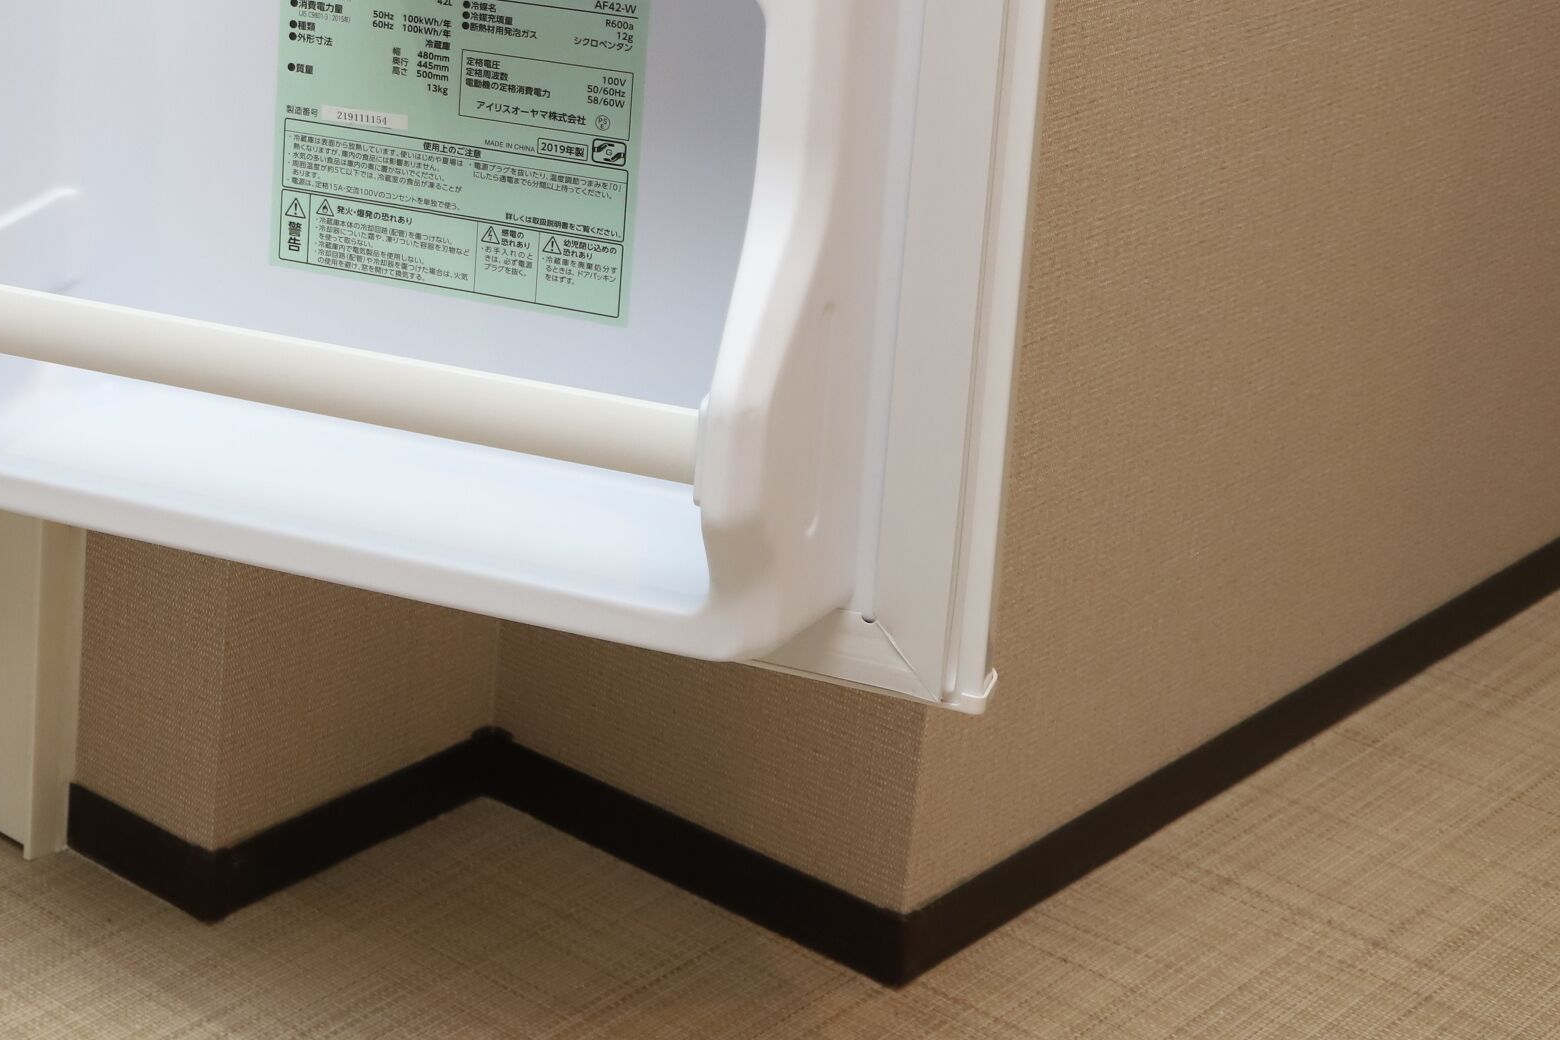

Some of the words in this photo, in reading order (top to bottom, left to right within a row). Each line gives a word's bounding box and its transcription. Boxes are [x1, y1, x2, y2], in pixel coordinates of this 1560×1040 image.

[594, 0, 637, 14] AF42-W
[373, 10, 394, 21] 50Hz
[402, 14, 452, 29] 100kWh/年
[605, 19, 634, 31] R600a
[372, 20, 394, 31] 60Hz
[402, 24, 452, 39] 100kWh/年
[573, 36, 633, 52] シクロペンタン
[617, 32, 634, 44] 12g
[425, 39, 451, 52] 冷蔵庫
[417, 51, 450, 63] 480mm
[466, 57, 501, 70] 定格電圧
[392, 56, 409, 67] 奥行
[416, 60, 450, 73] 445mm
[392, 66, 409, 77] 高さ
[416, 70, 449, 82] 500mm
[465, 67, 509, 81] 定格周波数
[465, 78, 551, 99] 電動機の定格消費電力
[602, 76, 627, 87] 100V
[427, 83, 449, 96] 13kg
[587, 84, 626, 98] 50/60Hz
[587, 95, 626, 108] 58/60W
[286, 104, 319, 118] 製造番号
[476, 100, 587, 126] アイリスオーヤマ株式会社
[337, 111, 388, 126] 219111154
[423, 141, 482, 159] 使用上のご注意
[484, 138, 504, 148] MADE
[514, 143, 536, 153] CHINA
[541, 142, 585, 158] 2019年製
[337, 205, 413, 225] 発火・爆発の恐れあり
[505, 213, 622, 239] 詳しくは取扱説明書をご覧ください。
[287, 221, 302, 252] 警告
[501, 229, 525, 240] 感電の
[501, 239, 531, 250] 恐れあり
[563, 239, 617, 255] 幼児閉じ込めの
[562, 248, 593, 260] 恐れあり
